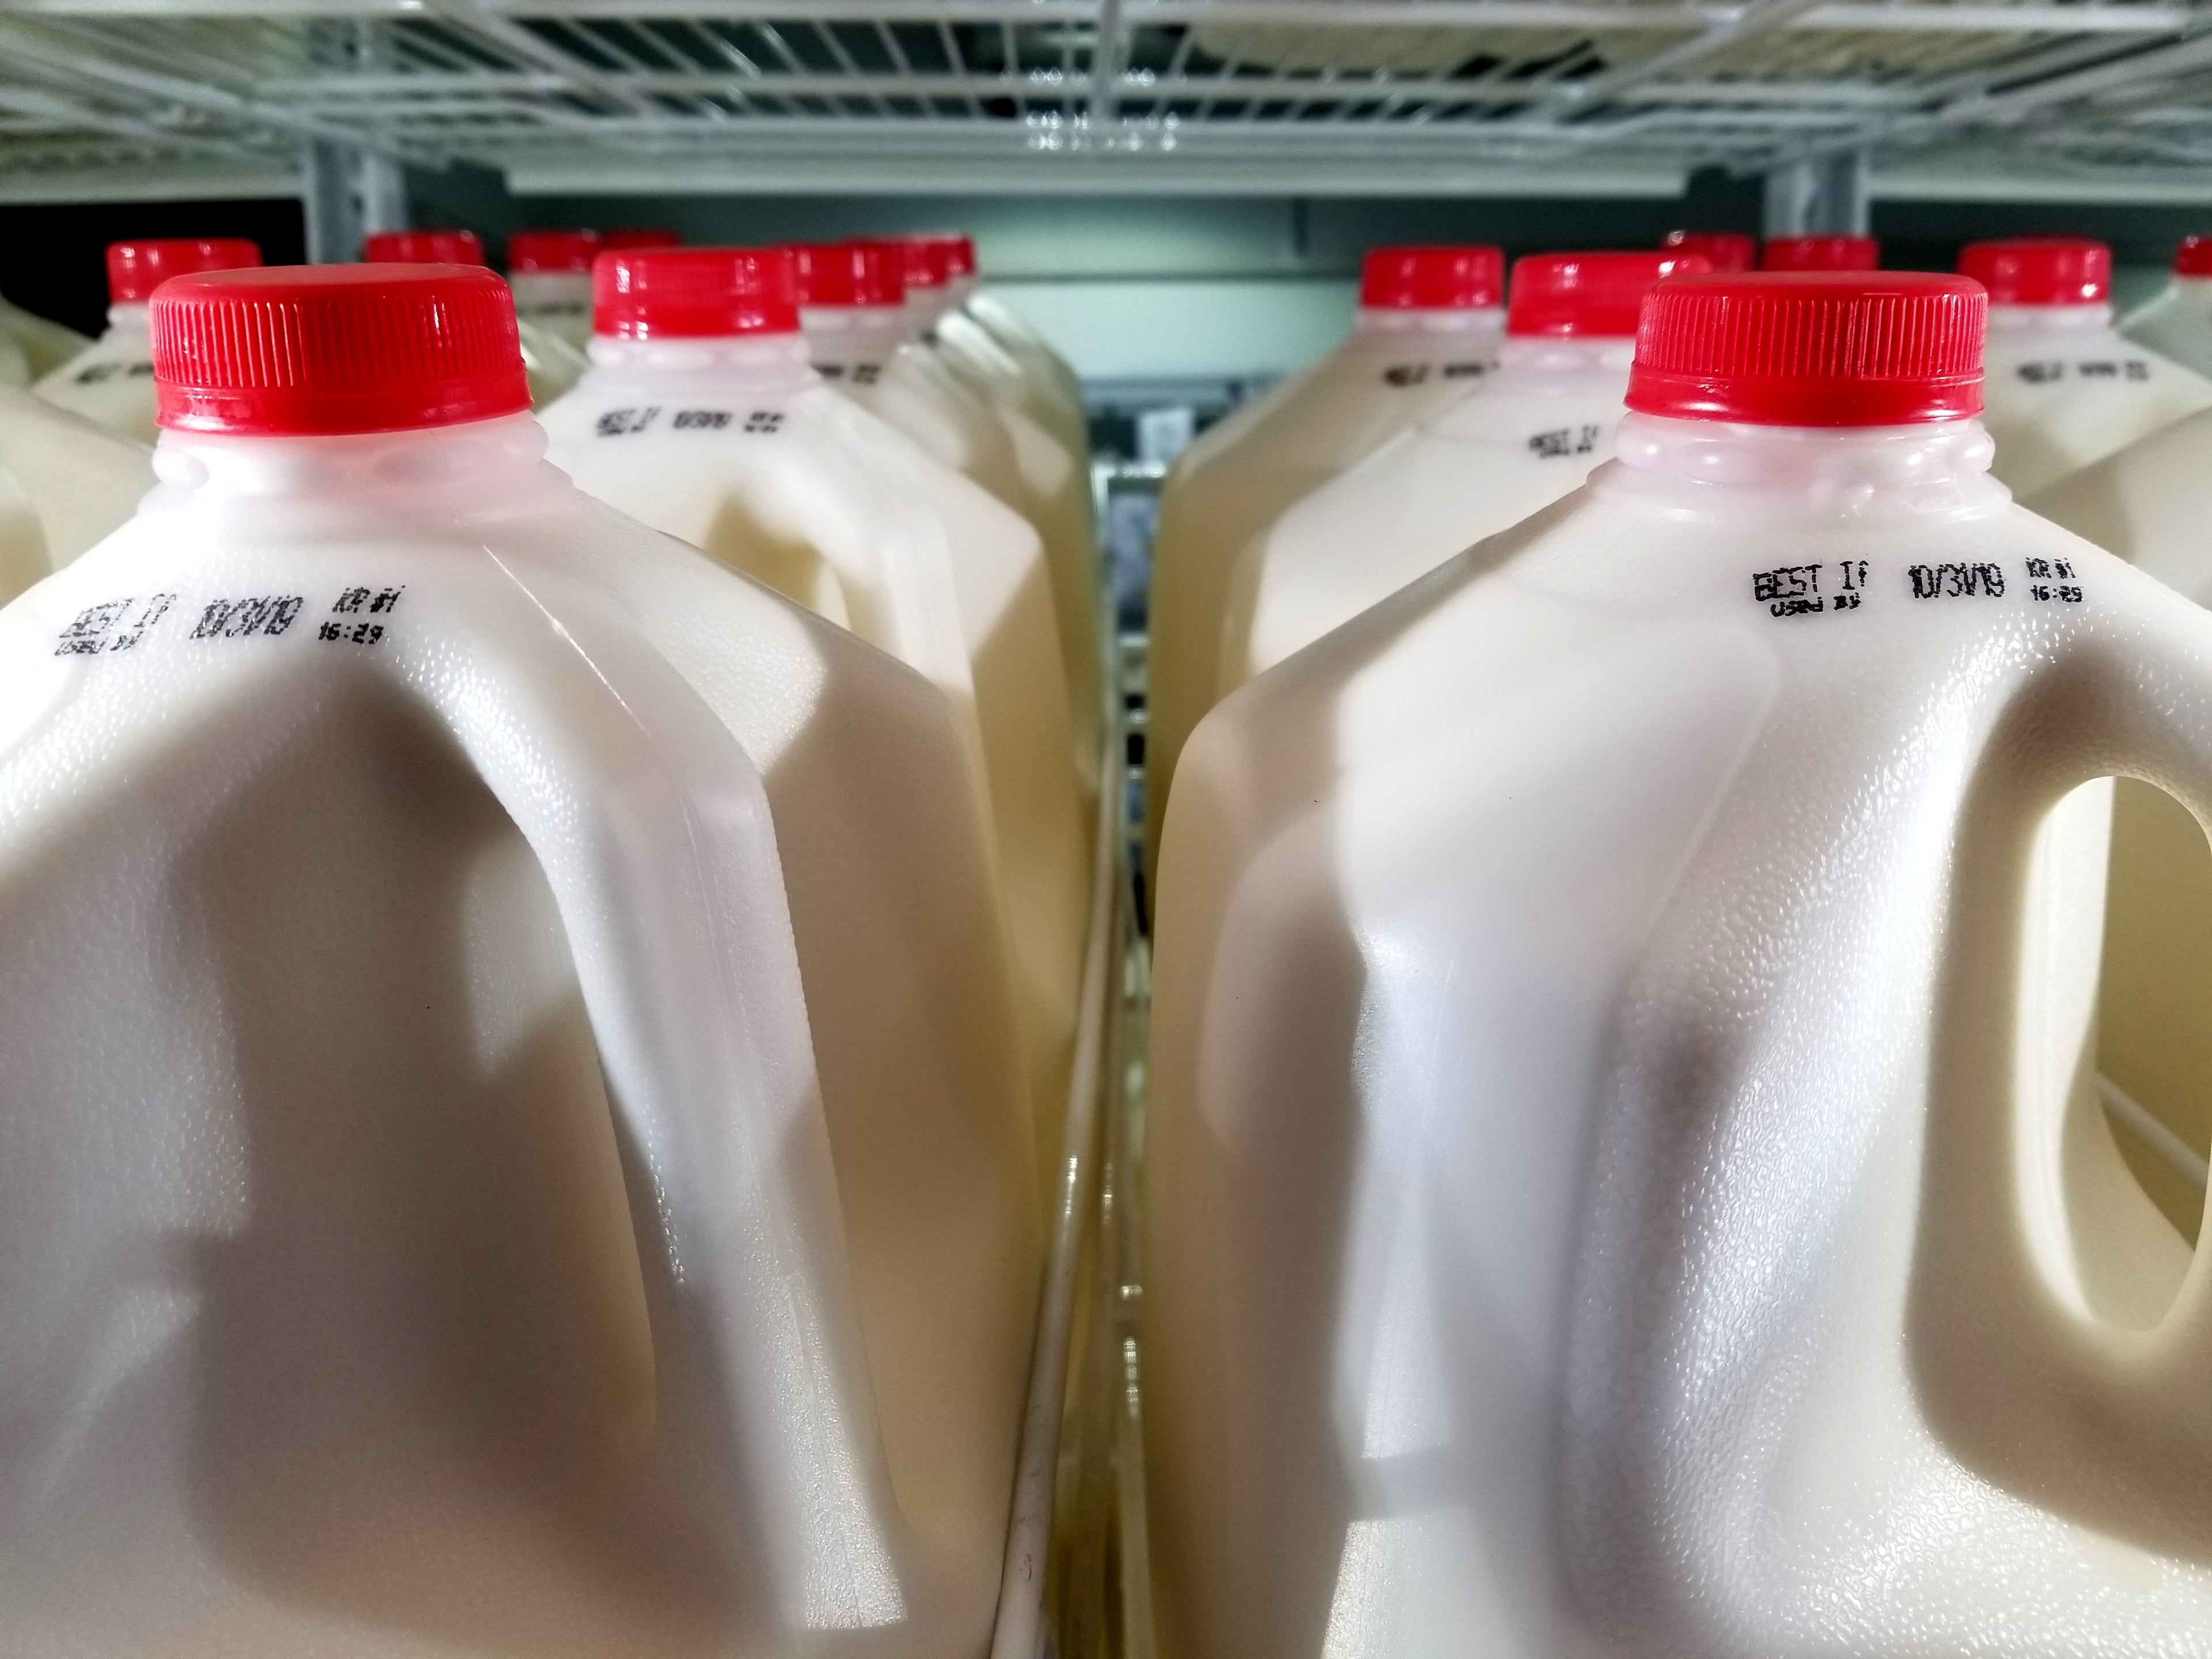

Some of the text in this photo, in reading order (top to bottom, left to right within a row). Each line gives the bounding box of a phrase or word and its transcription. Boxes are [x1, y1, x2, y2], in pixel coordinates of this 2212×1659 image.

[1752, 564, 1823, 602] BEST
[2029, 584, 2084, 603] 16:29
[317, 622, 384, 645] 16:29
